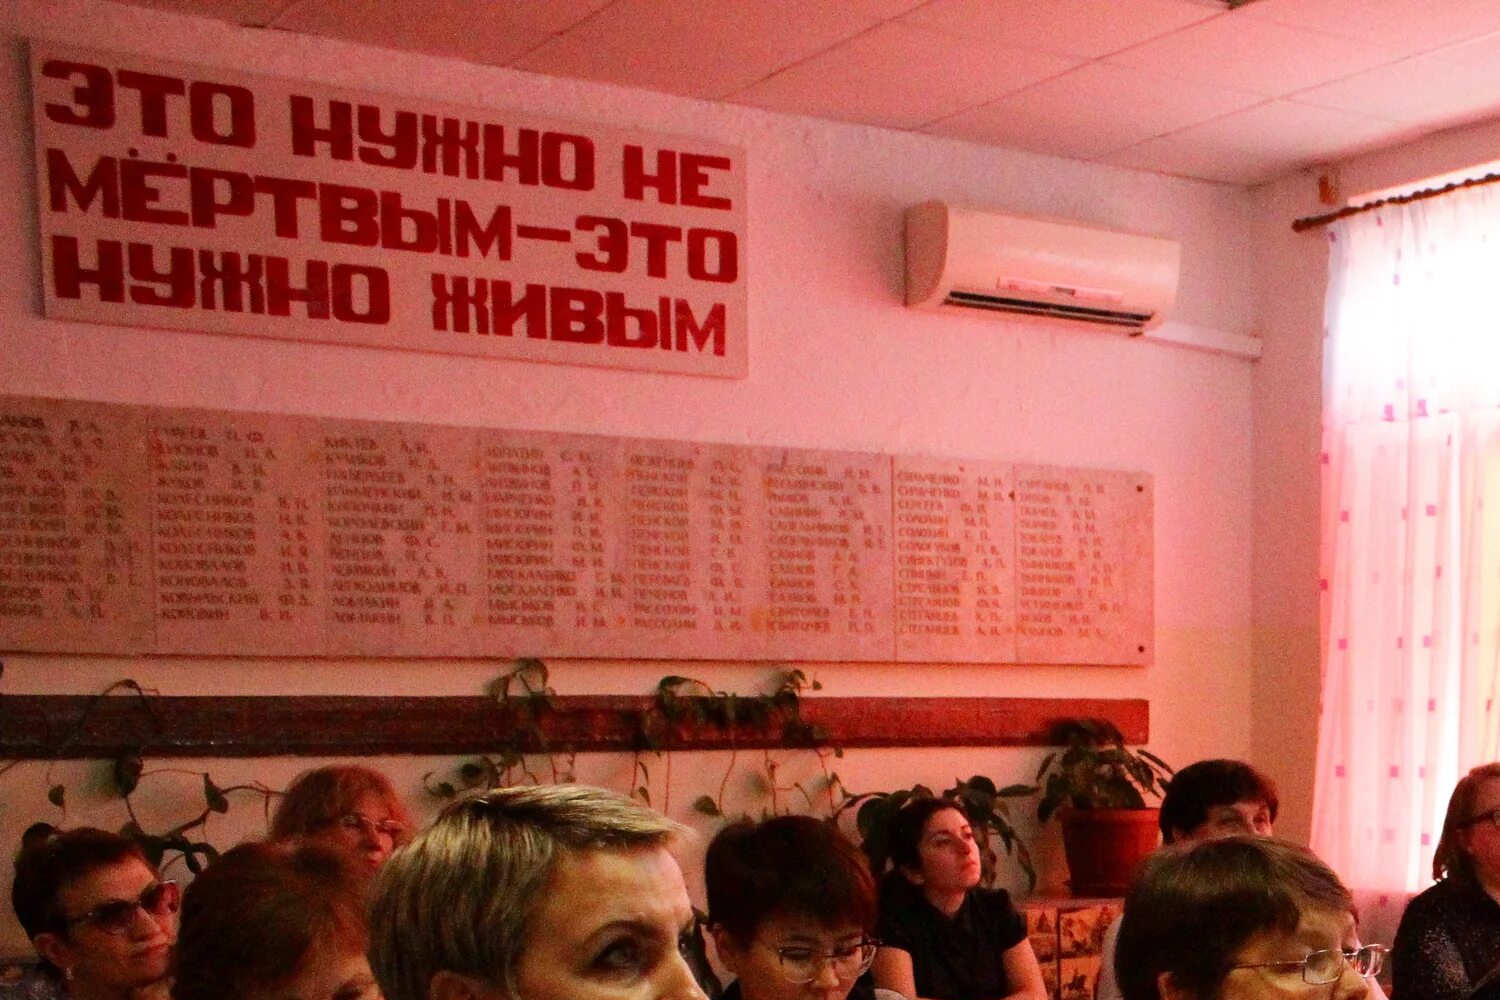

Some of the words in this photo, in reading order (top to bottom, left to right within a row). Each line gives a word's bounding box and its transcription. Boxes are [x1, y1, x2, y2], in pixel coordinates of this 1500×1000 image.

[41, 60, 257, 150] ЭТО
[289, 93, 596, 192] НУЖНО
[622, 144, 733, 211] НЕ
[49, 234, 391, 326] НУЖНО
[430, 273, 727, 357] ЖИВЫМ
